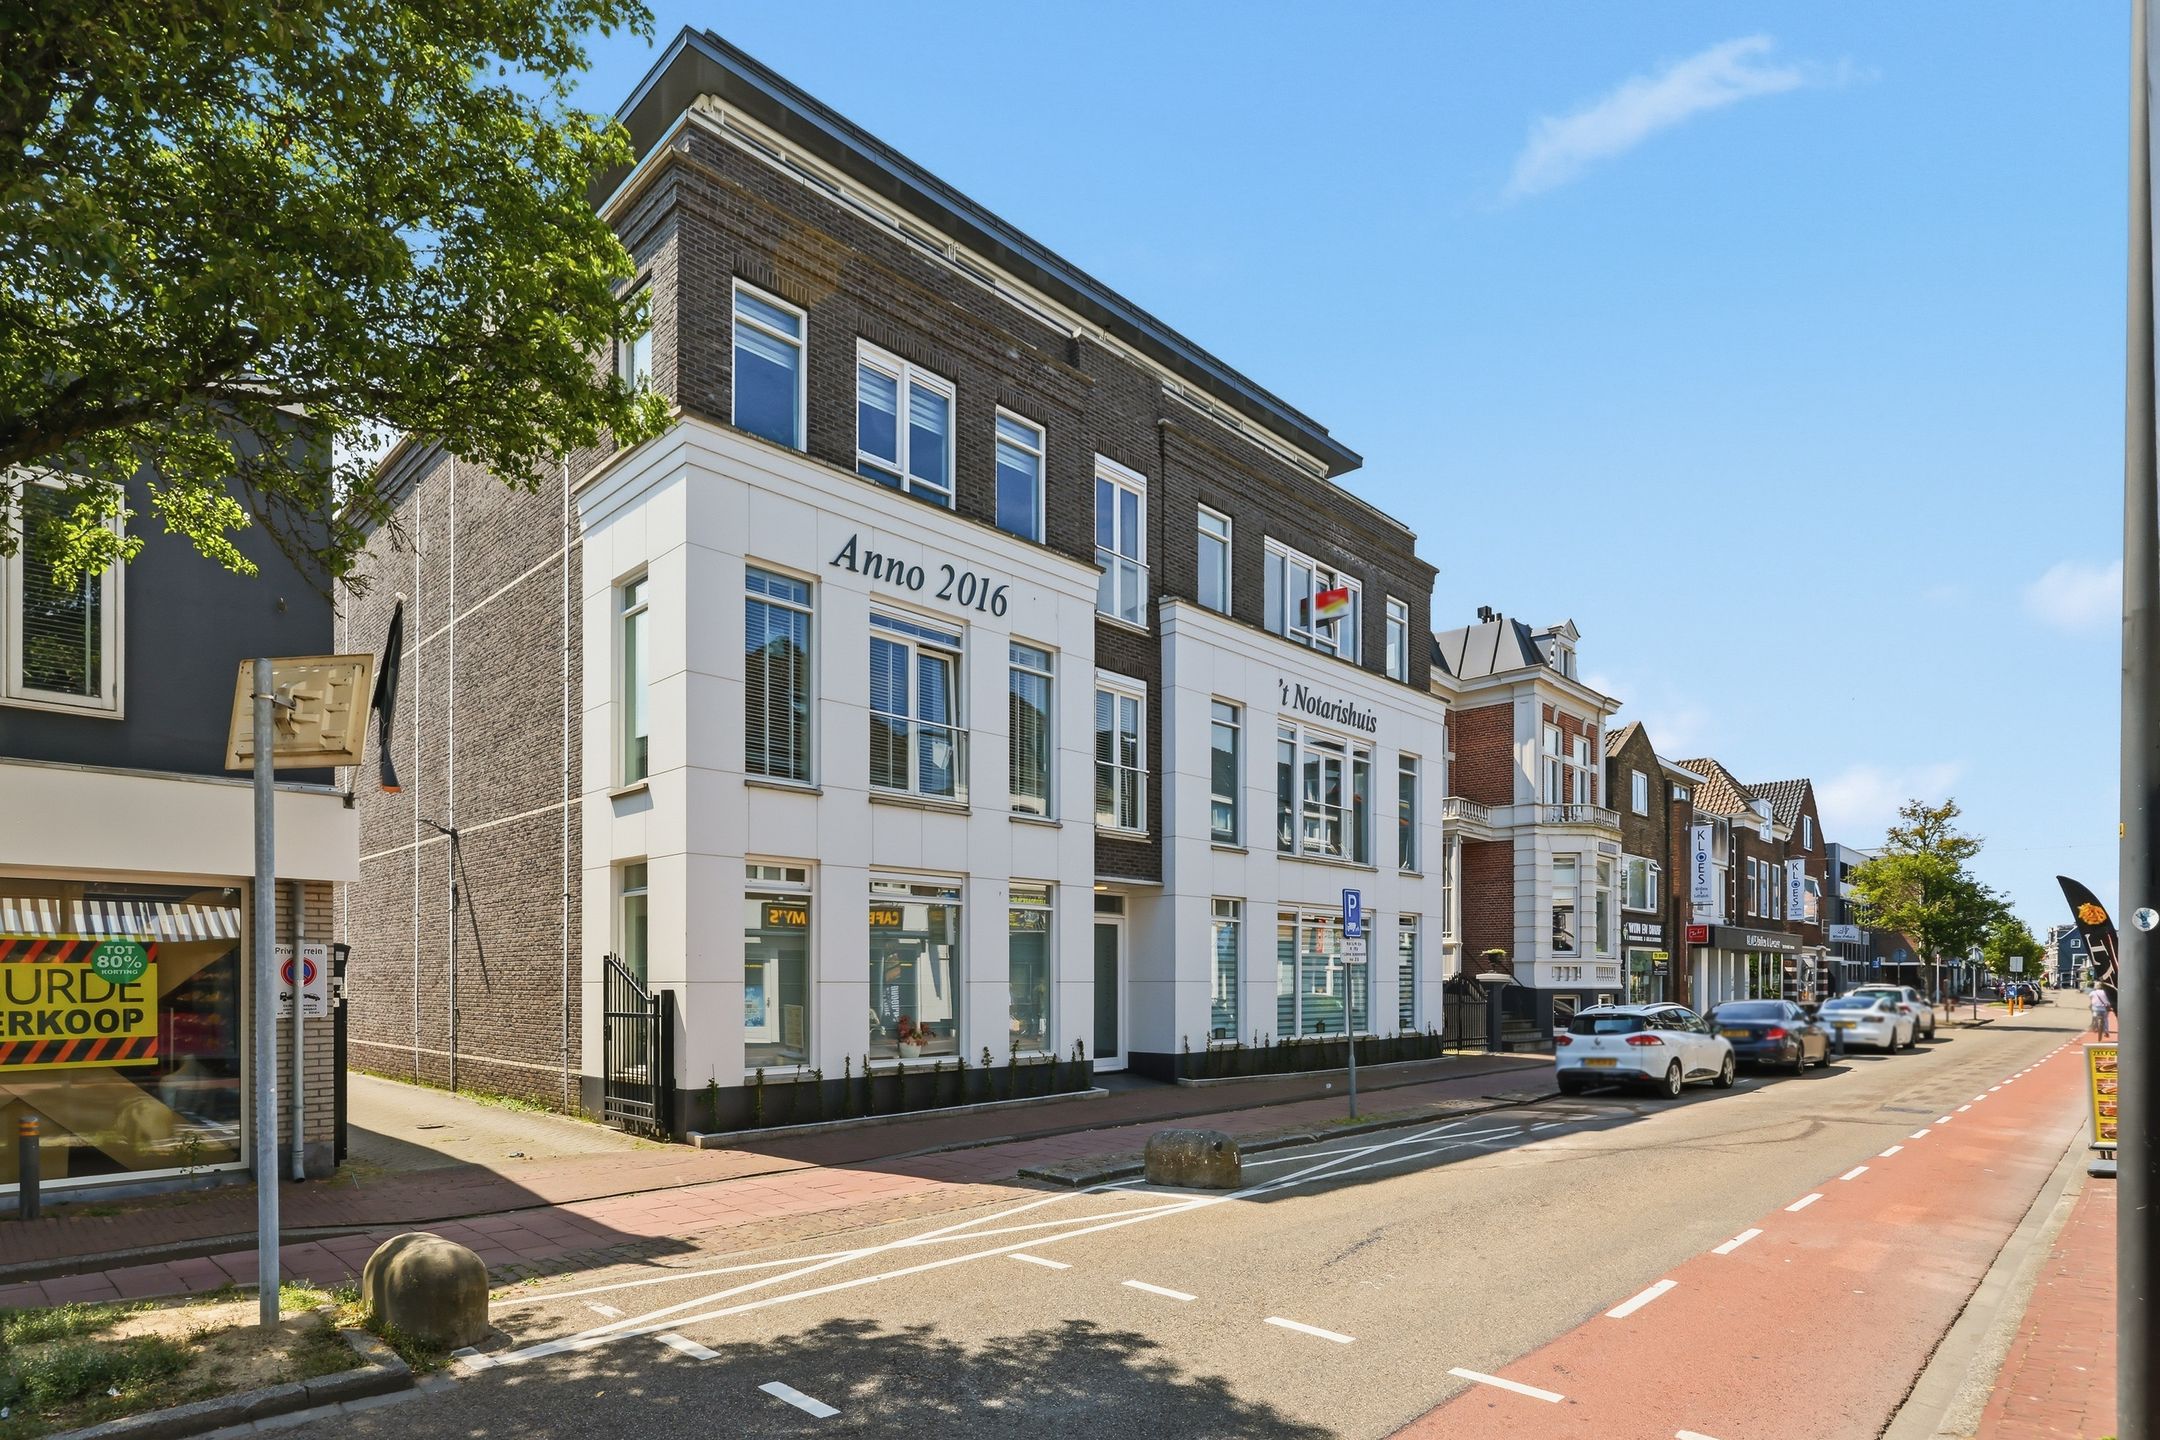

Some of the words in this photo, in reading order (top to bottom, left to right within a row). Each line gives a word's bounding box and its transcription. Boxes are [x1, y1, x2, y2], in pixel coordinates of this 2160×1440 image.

[829, 533, 925, 591] Anno
[936, 563, 1010, 617] 2016
[1293, 683, 1377, 733] Notarishuis
[1696, 830, 1707, 884] KLOES
[1348, 894, 1357, 917] P
[96, 955, 142, 969] 80%
[104, 945, 135, 955] TOT
[5, 968, 144, 1005] URDE
[0, 1008, 144, 1037] RKOOP
